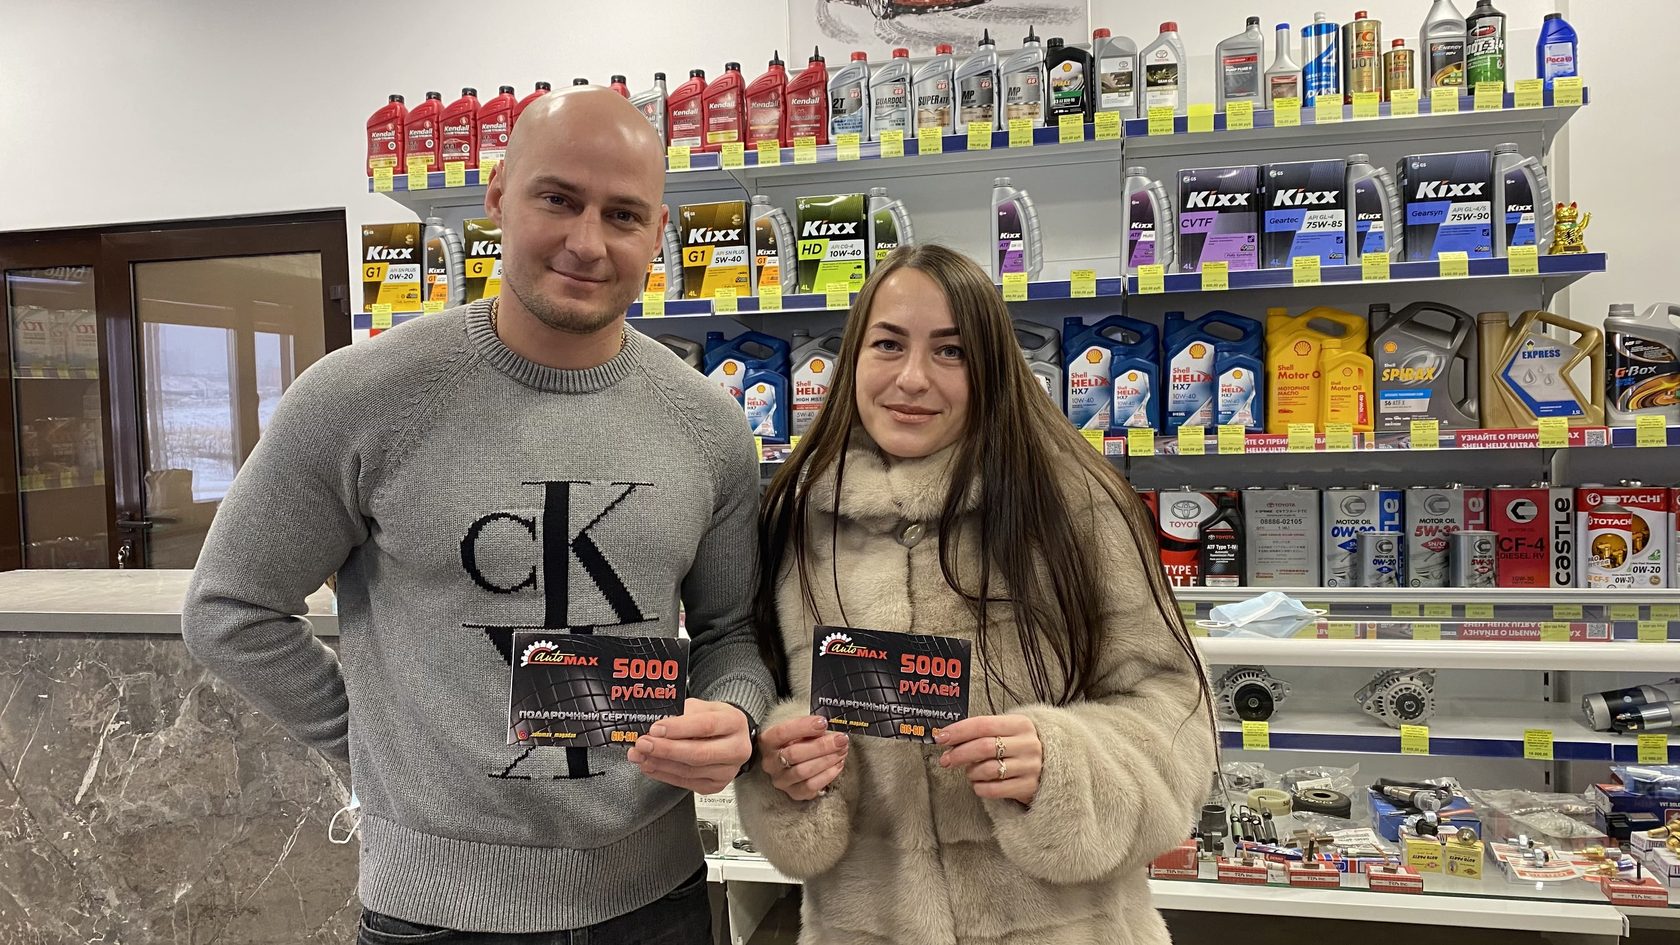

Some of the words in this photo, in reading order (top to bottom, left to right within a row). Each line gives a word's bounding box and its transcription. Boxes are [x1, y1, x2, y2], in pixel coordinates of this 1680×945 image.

[962, 90, 974, 100] MP
[1008, 87, 1020, 96] MP
[709, 101, 736, 110] Kendall
[751, 101, 779, 109] Kendall
[832, 98, 845, 109] 2T
[918, 96, 938, 106] SUPER
[673, 108, 698, 116] Kendall
[444, 125, 469, 133] Kendall
[482, 122, 507, 130] Kendall
[409, 128, 432, 136] Kendall
[1415, 181, 1486, 199] Kixx
[1186, 191, 1250, 208] Kixx
[1273, 189, 1339, 206] Kixx
[1507, 204, 1532, 212] Kixx
[1411, 209, 1443, 218] Gearsyn
[1451, 212, 1489, 221] 75W-90
[802, 220, 858, 236] Kixx
[1181, 217, 1214, 228] CVTF
[1306, 220, 1342, 229] 75W-85
[688, 228, 741, 243] Kixx
[366, 246, 414, 261] Kixx
[471, 241, 502, 256] Kix
[801, 243, 822, 255] HD
[688, 250, 705, 262] G1
[366, 267, 381, 278] G1
[1522, 350, 1560, 359] EXPRESS
[1172, 372, 1213, 382] HELIX
[1278, 372, 1309, 380] Motor
[1382, 368, 1436, 382] SPIRAX
[1071, 377, 1111, 388] HELIX
[1500, 537, 1545, 552] CF-4
[1165, 565, 1191, 575] TYPE
[613, 658, 678, 680] 5000
[900, 653, 962, 679] 5000
[611, 683, 676, 700] рублей
[899, 679, 960, 698] рублей
[819, 697, 889, 713] ПОДАРОЧНЫЙ
[891, 705, 960, 721] СЕРТИФИКАТ
[519, 710, 599, 722] ПОДАРОЧНЫЙ
[900, 724, 924, 737] 616-616
